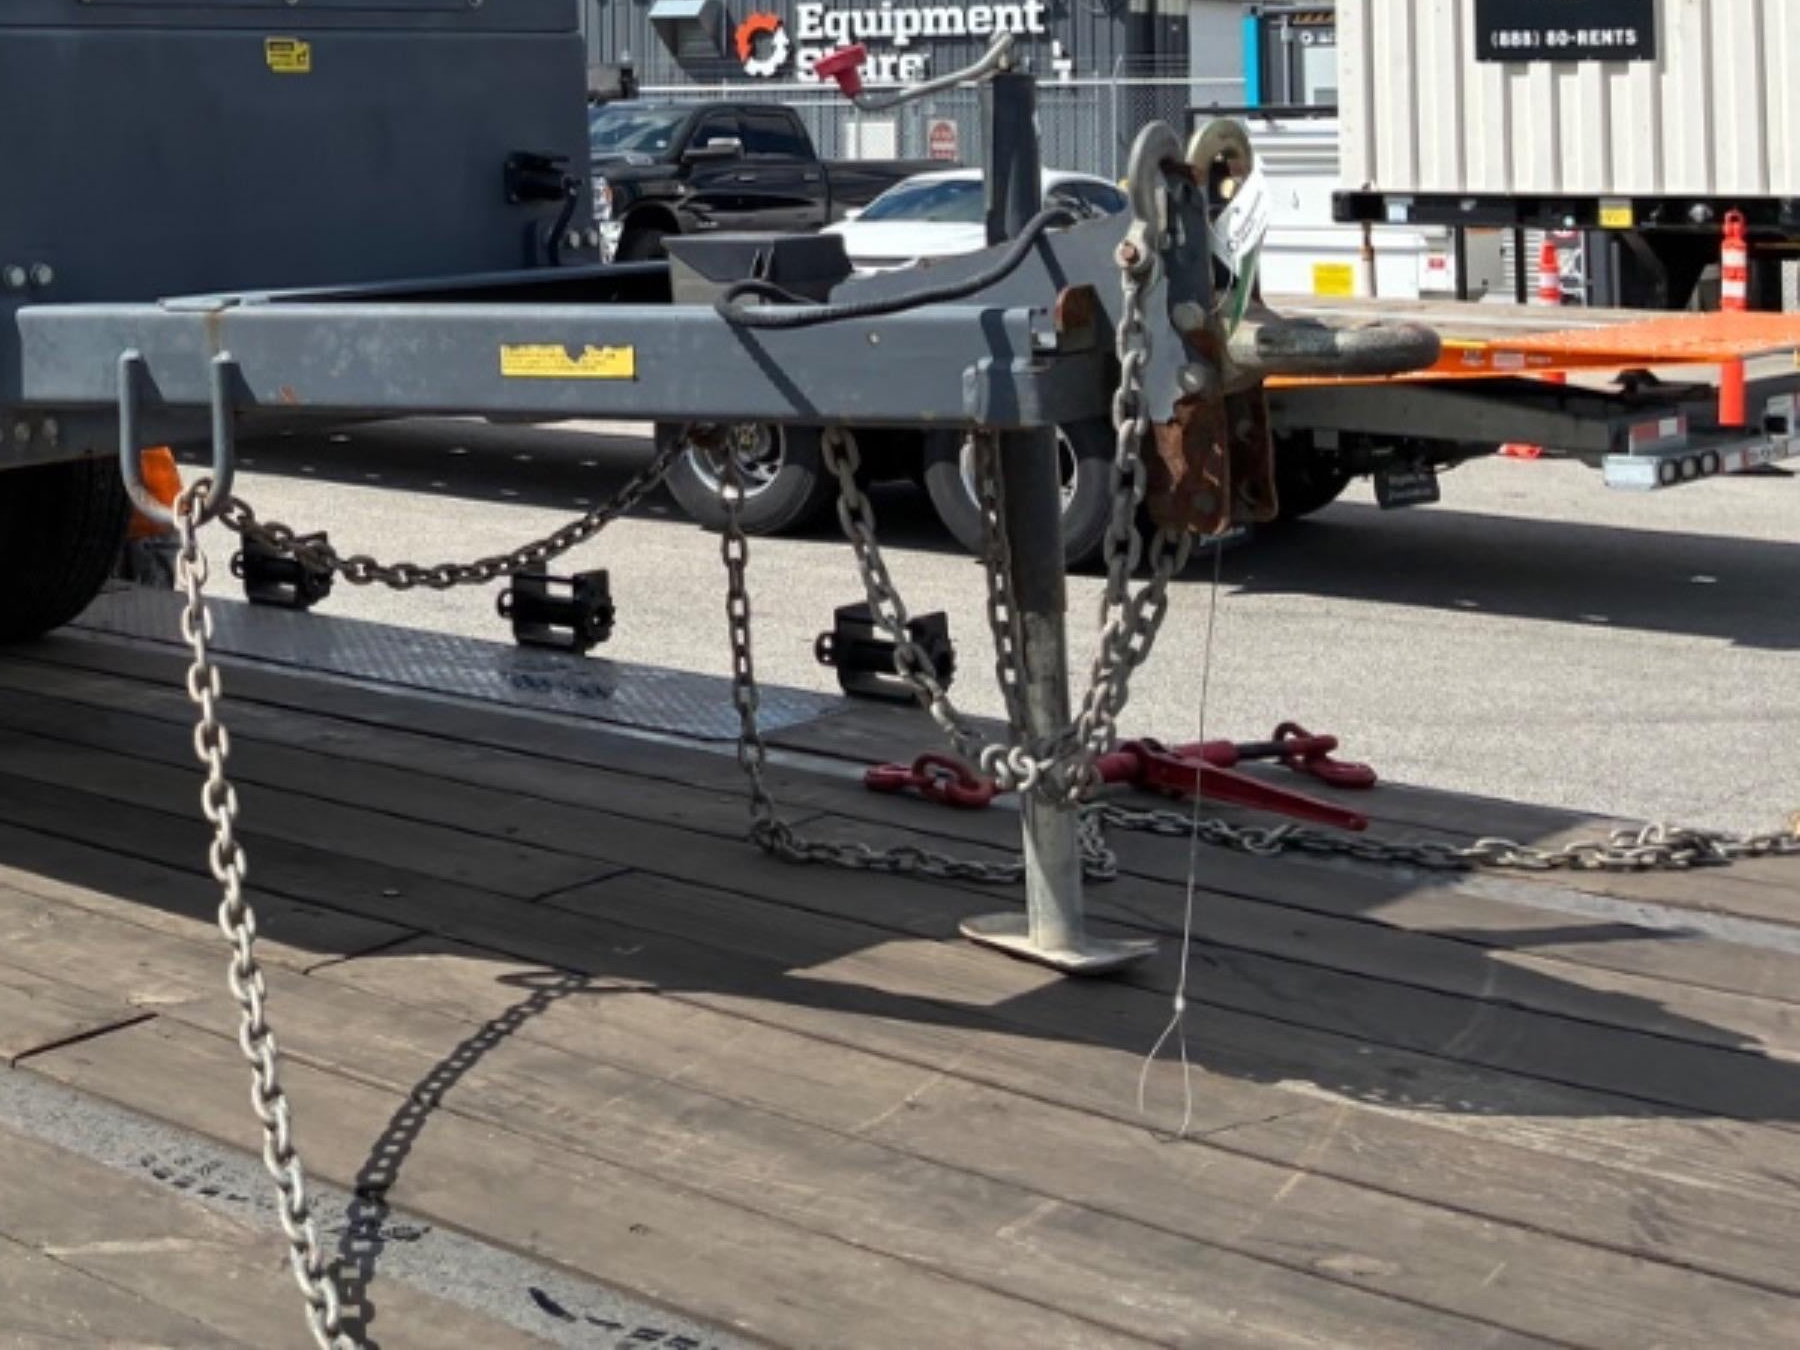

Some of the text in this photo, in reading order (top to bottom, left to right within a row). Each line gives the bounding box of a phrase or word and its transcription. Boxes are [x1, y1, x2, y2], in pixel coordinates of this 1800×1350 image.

[1491, 28, 1638, 49] (888) 80-RENTS
[796, 46, 924, 83] Sare
